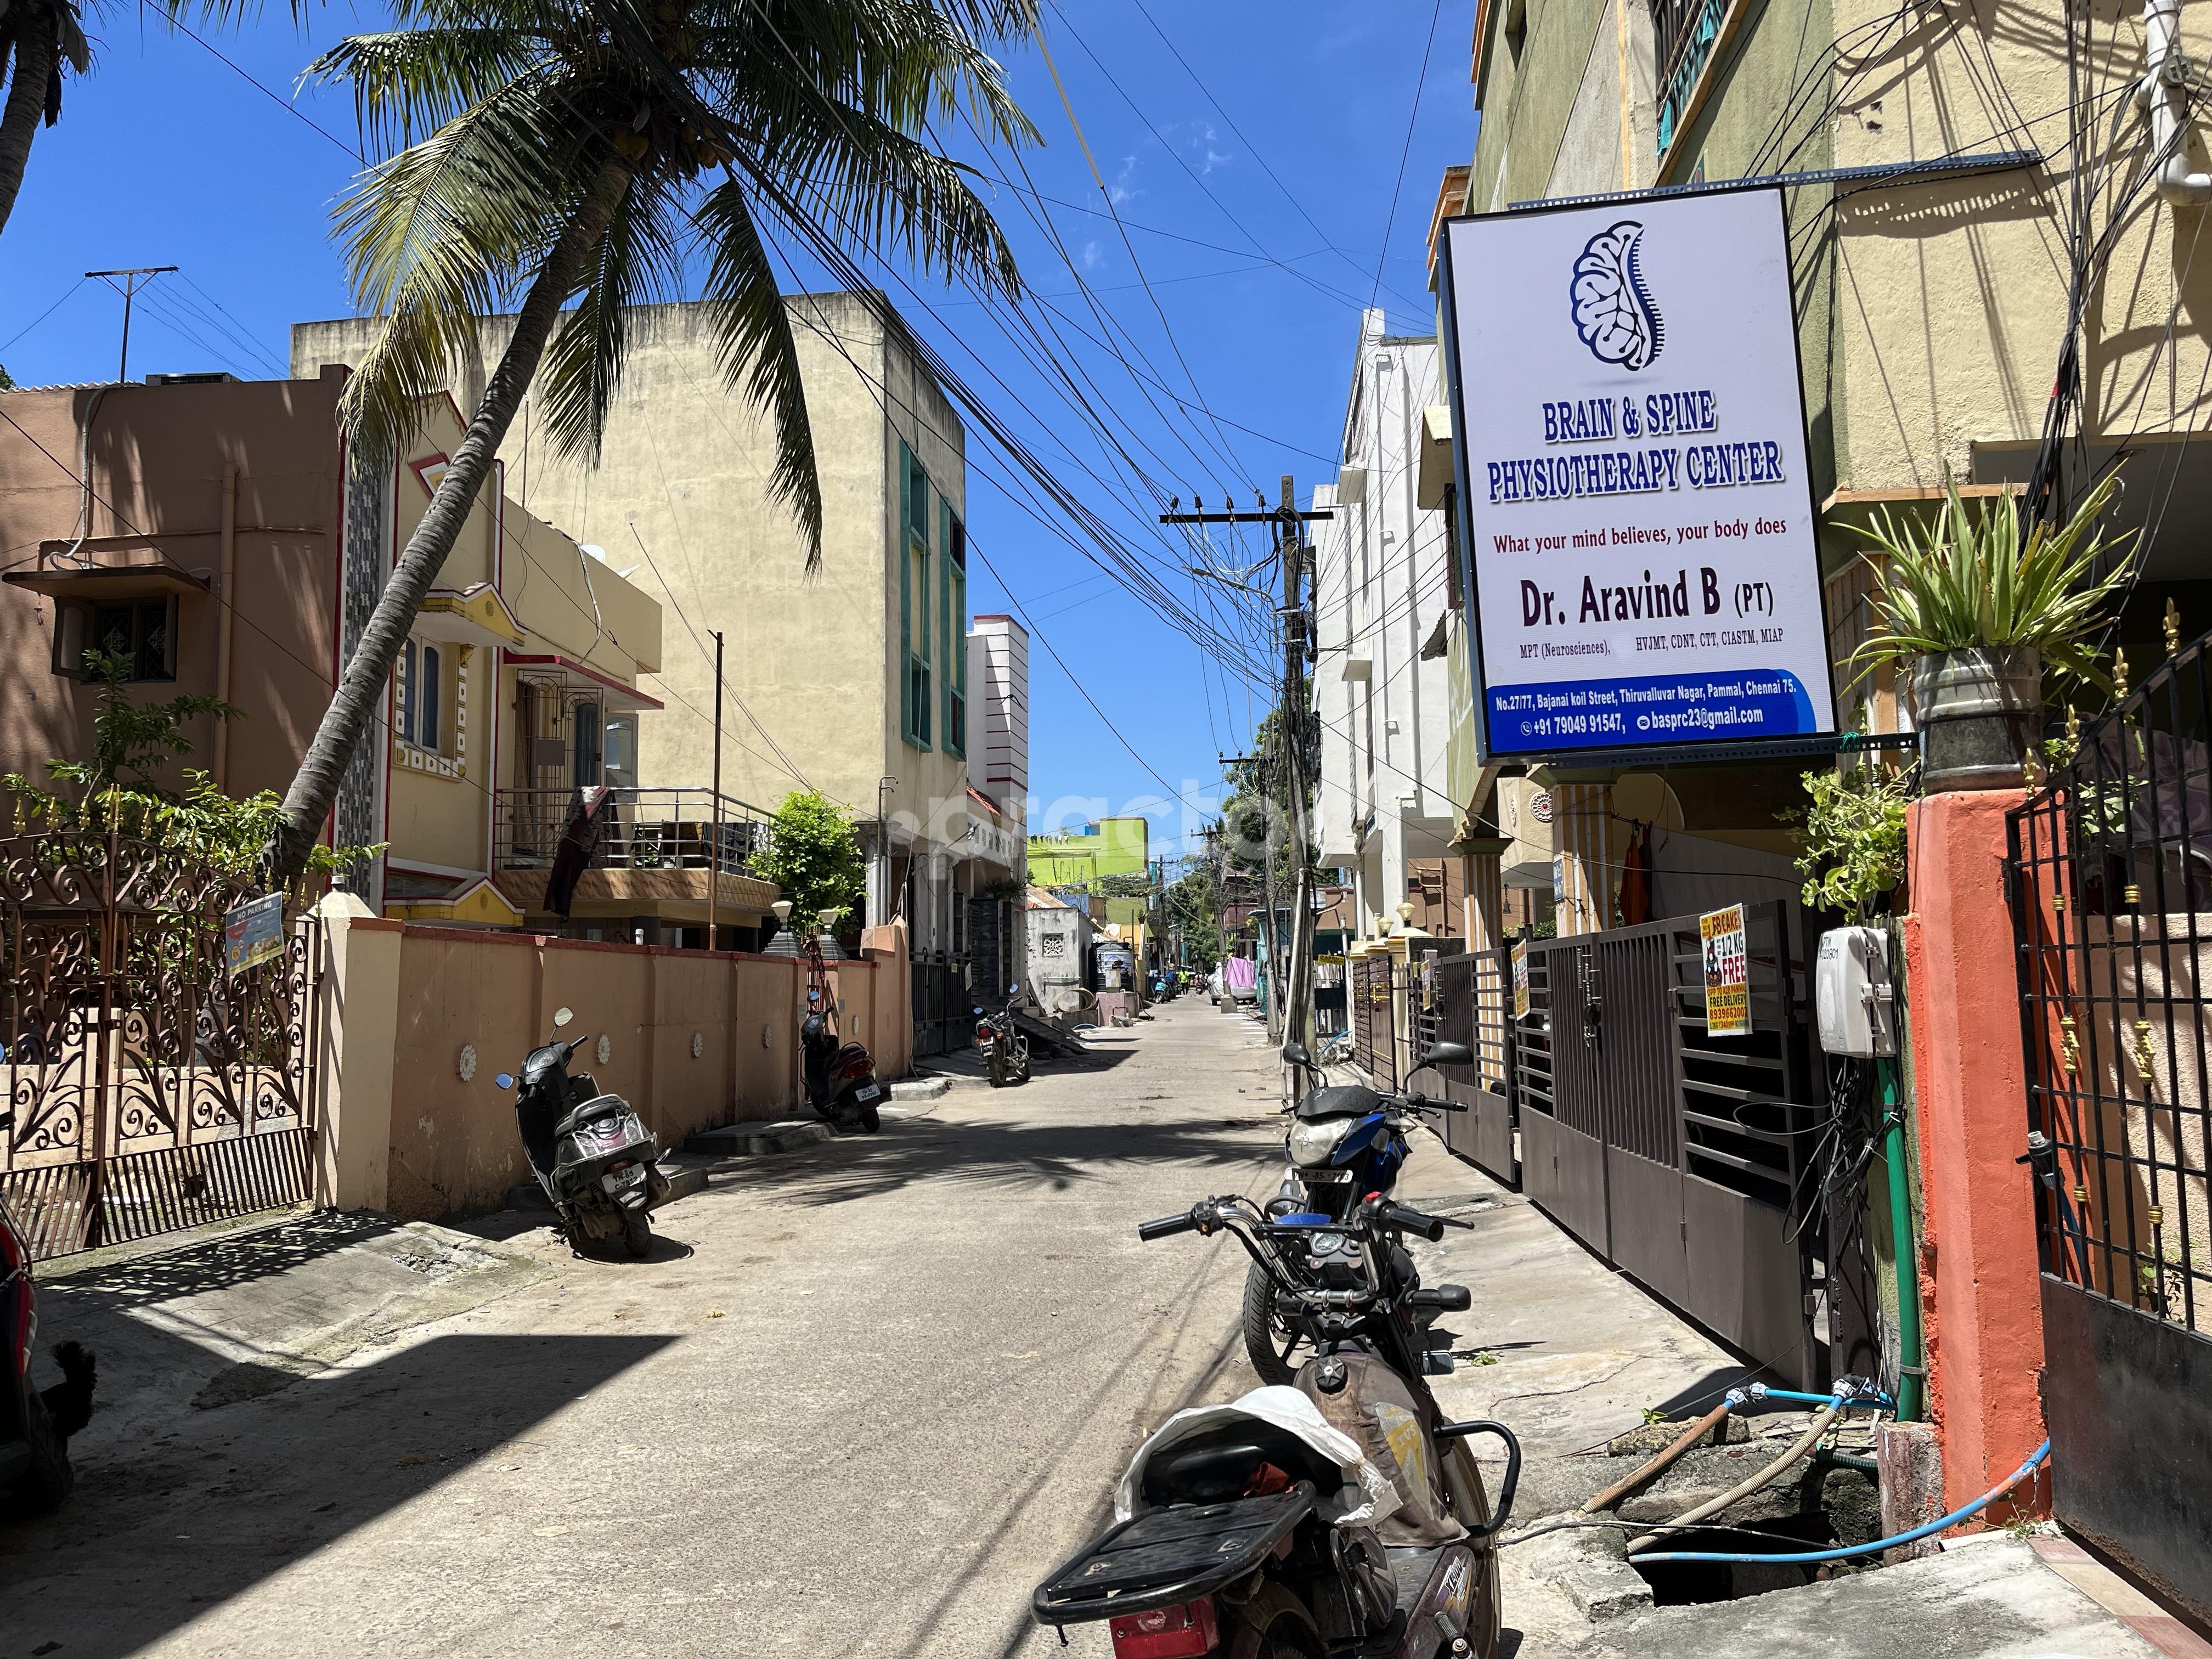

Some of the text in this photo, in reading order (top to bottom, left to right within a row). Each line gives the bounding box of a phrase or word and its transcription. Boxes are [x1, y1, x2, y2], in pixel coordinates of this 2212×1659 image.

[1543, 391, 1716, 441] BRAIN & SPINE
[1488, 441, 1783, 501] PHYSIOTHERAPY CENTER
[1493, 517, 1787, 554] What your mind believes, your body does
[1520, 567, 1774, 627] Dr. Aravind B (PT)
[1520, 628, 1784, 661] MPT (Neurosciences), HVJMT, CDNT, CTT, CIASTM, MIAP
[1496, 679, 1797, 712] No.27/77, Bajanai koil Street, Thiruvalluvar Nagar, Pammal, Chennai 75.
[1534, 706, 1764, 736] +91 79049 91547, basprc23@gmail.com
[237, 900, 272, 921] NO PARKING
[1722, 936, 1733, 957] 1/2
[1734, 931, 1743, 954] KG
[1722, 955, 1746, 985] FREE
[1709, 993, 1747, 1008] FREE DELIVERY
[1717, 987, 1723, 996] TO
[1709, 1006, 1748, 1020] 8939662002
[1396, 1424, 1417, 1448] TVS
